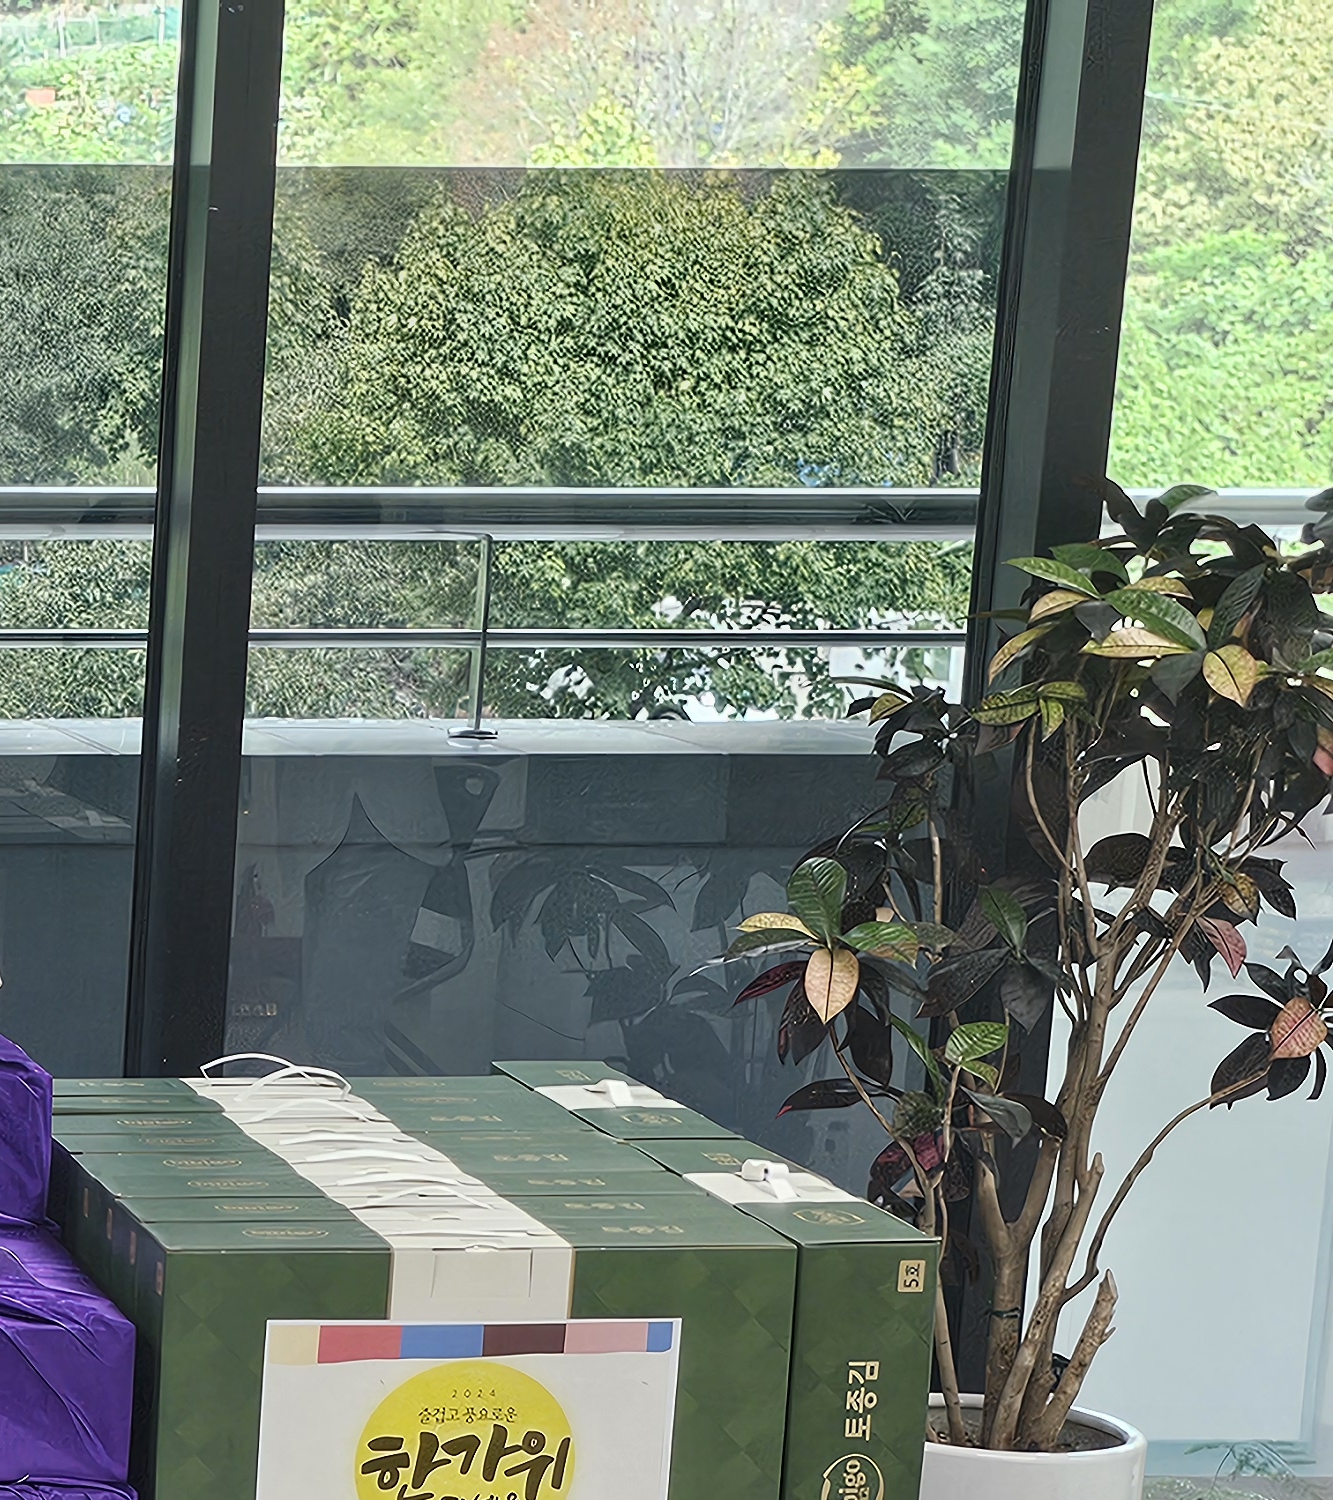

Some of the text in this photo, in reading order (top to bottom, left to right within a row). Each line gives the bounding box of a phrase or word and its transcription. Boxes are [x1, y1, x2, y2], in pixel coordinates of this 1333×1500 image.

[903, 1263, 921, 1288] 5호
[451, 1389, 497, 1398] 2024
[845, 1360, 880, 1441] 토종김
